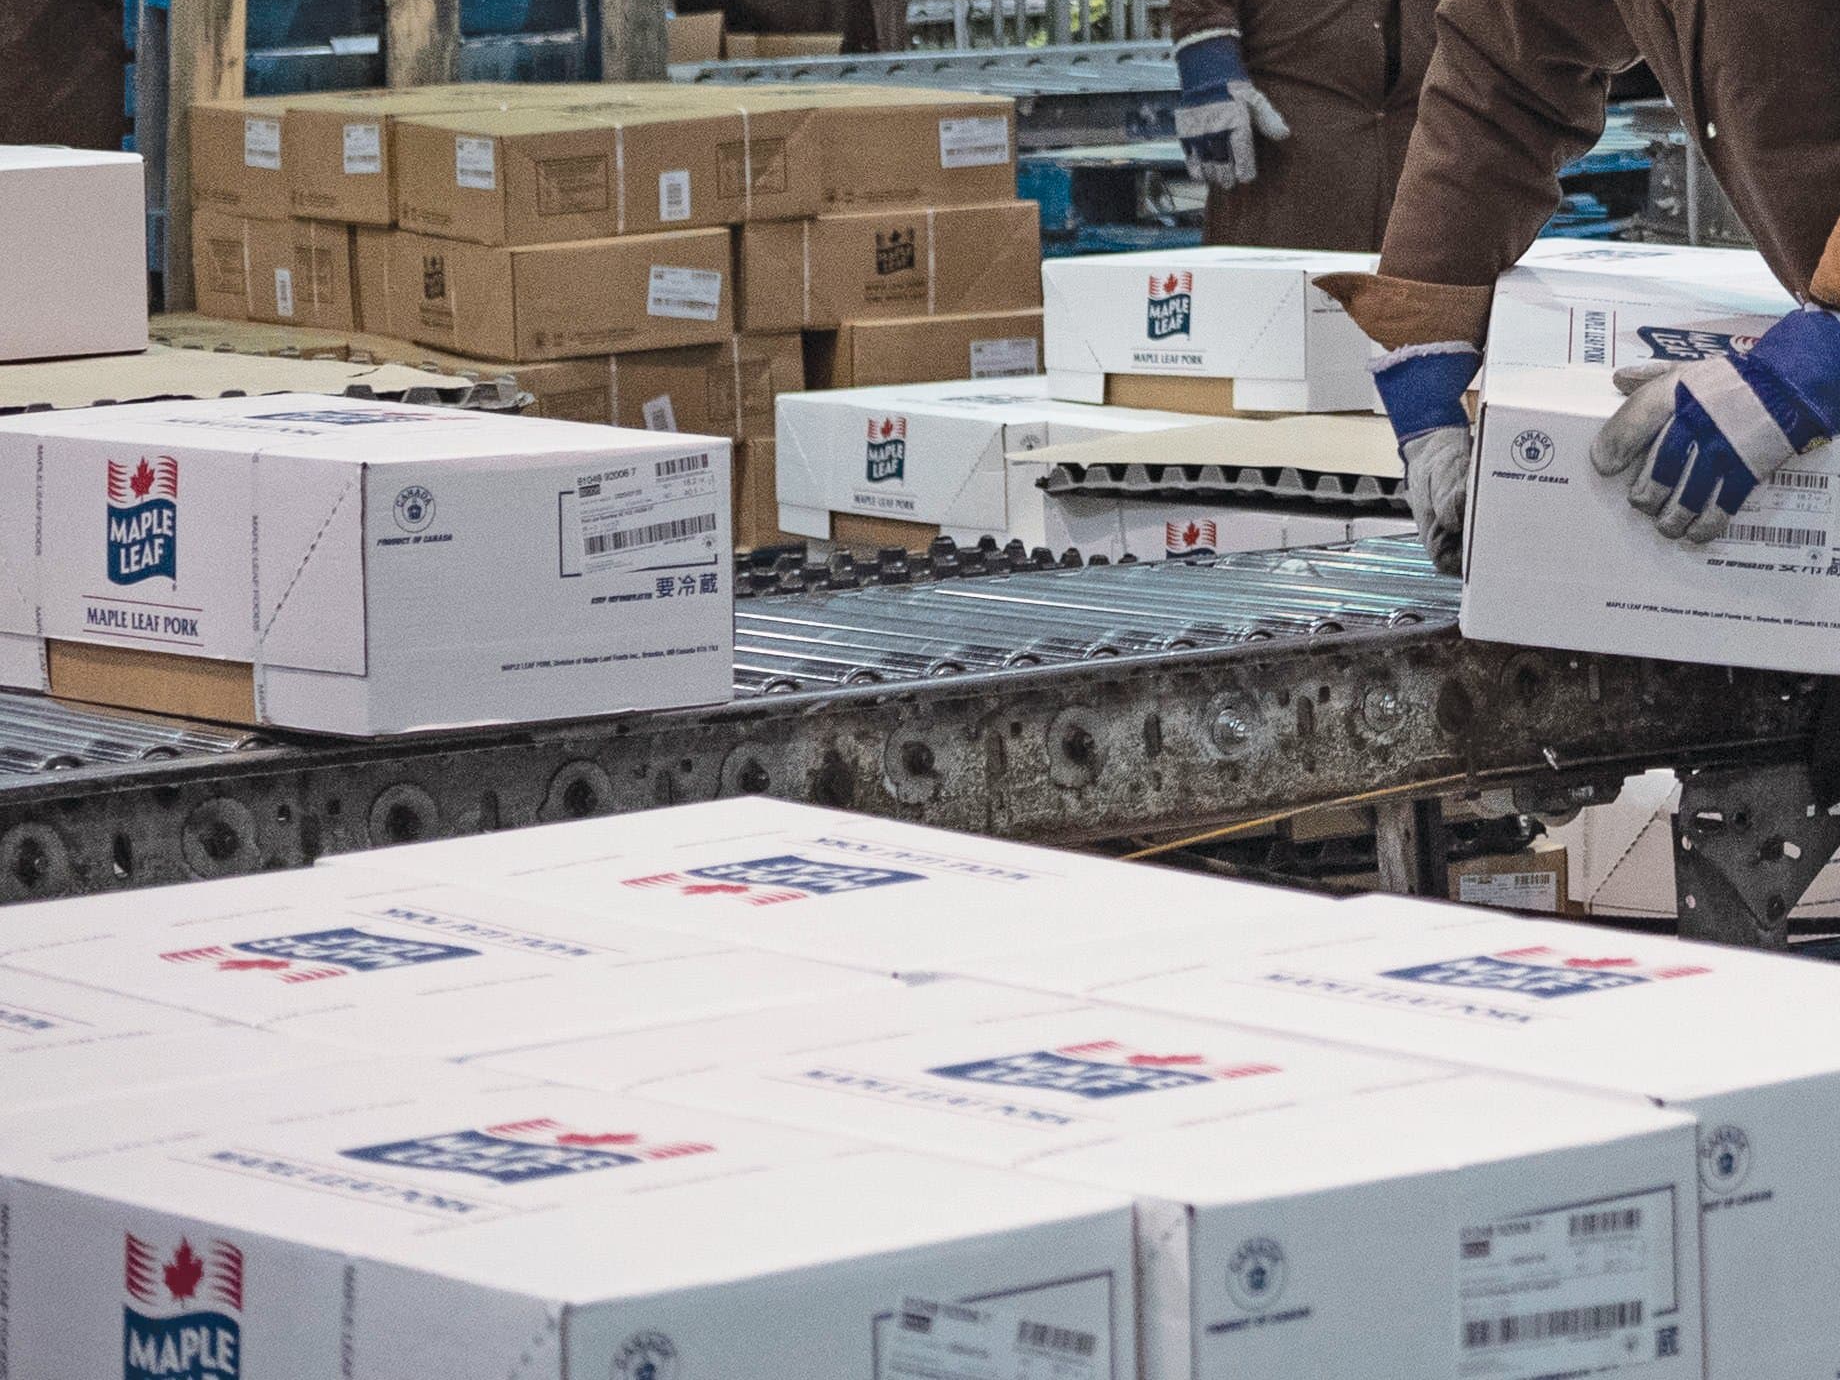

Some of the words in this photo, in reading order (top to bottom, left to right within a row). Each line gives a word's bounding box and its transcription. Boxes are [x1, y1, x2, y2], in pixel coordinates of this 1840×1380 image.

[1150, 298, 1190, 320] MAPLE
[1154, 314, 1184, 334] LEAF
[1585, 310, 1606, 331] MAPLE
[1584, 331, 1605, 346] LEAF
[1133, 353, 1158, 365] MAPLE
[1160, 353, 1179, 365] LEAF
[1181, 354, 1203, 366] PORK
[1584, 346, 1605, 364] PORK
[1513, 430, 1552, 450] CANADA
[868, 441, 904, 461] MAPLE
[872, 460, 899, 476] LEAF
[1491, 470, 1526, 482] PRODUCT
[1528, 473, 1538, 482] OF
[1538, 474, 1570, 485] CANADA
[395, 485, 432, 508] CANADA
[109, 508, 174, 544] MAPLE
[413, 535, 422, 544] OF
[119, 537, 165, 576] LEAF
[655, 573, 718, 599] 要冷蔵
[1606, 601, 1625, 610] MAPLE
[1626, 602, 1642, 611] LEAF
[86, 606, 128, 630] MAPLE
[131, 611, 161, 634] LEAF
[163, 614, 199, 638] PORK
[701, 863, 868, 890] MAPLE
[760, 861, 892, 881] LEAF
[249, 937, 414, 966] MAPLE
[310, 935, 446, 957] LEAF
[415, 1137, 619, 1172] MAPLE
[127, 1326, 236, 1375] MAPLE
